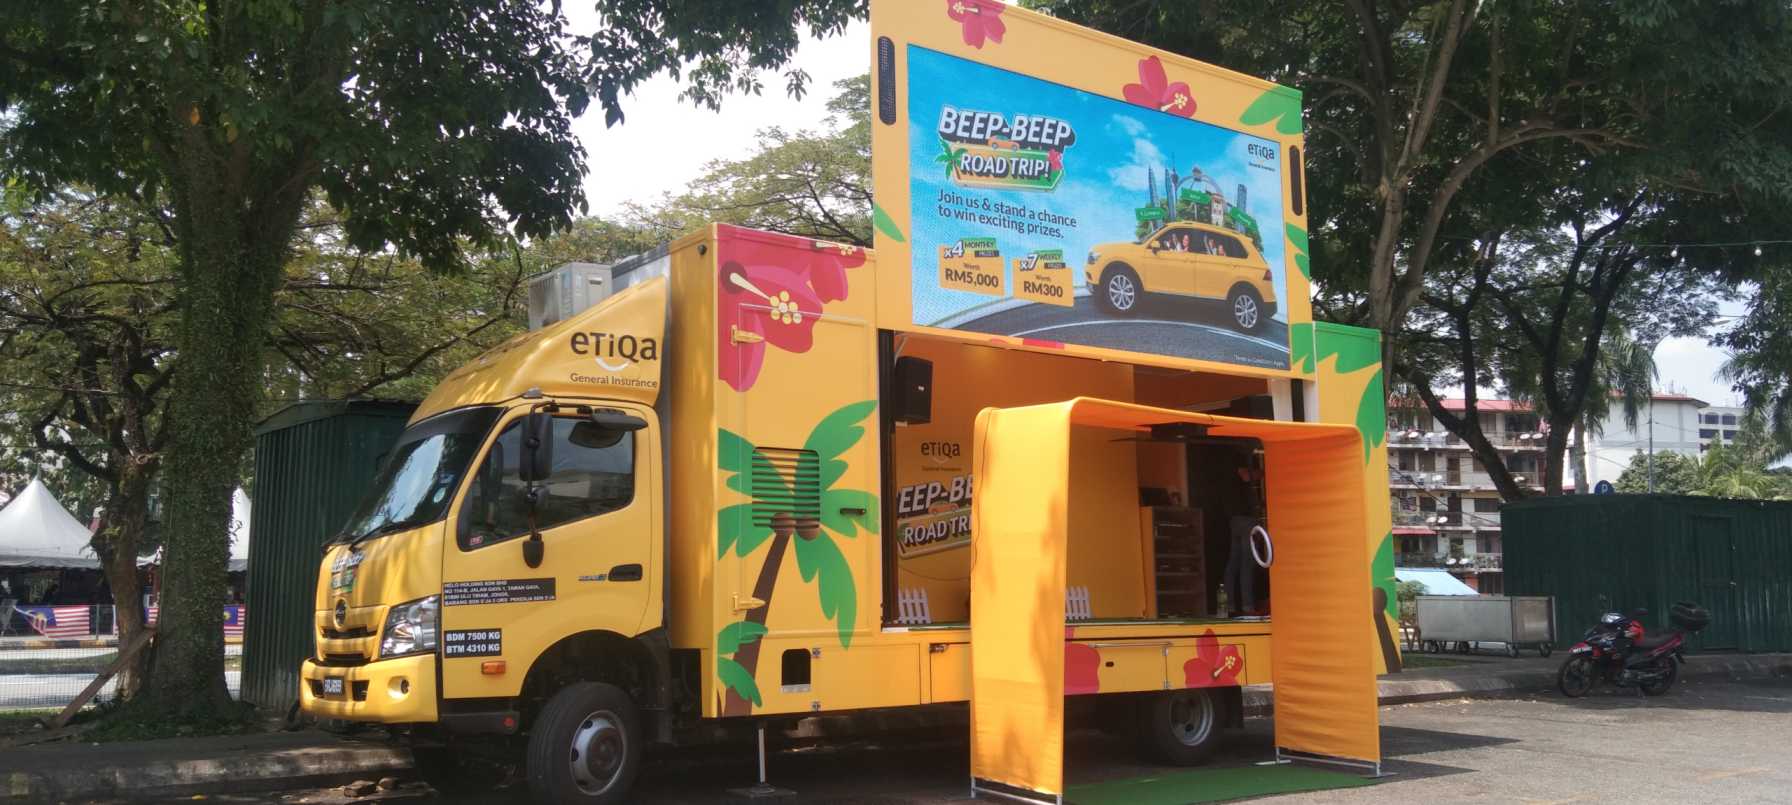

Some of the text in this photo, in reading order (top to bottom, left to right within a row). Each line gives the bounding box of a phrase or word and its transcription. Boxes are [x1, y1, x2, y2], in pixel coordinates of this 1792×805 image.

[939, 106, 1072, 146] BEEP-BEEP
[960, 153, 1050, 178] ROAD TRIP!
[938, 188, 1077, 228] Join us & stand a chance
[938, 204, 952, 217] to
[953, 208, 976, 222] win
[978, 213, 1025, 234] exciting
[943, 240, 964, 259] x4
[1019, 253, 1039, 272] x7
[945, 268, 999, 288] RM5,000
[1023, 280, 1063, 298] RM300
[569, 372, 658, 388] General Insurance
[897, 474, 975, 513] EEP-BE
[904, 521, 947, 545] ROAD
[446, 631, 501, 641] BDM 7500 KG
[446, 643, 501, 654] BTM 4310 KG
